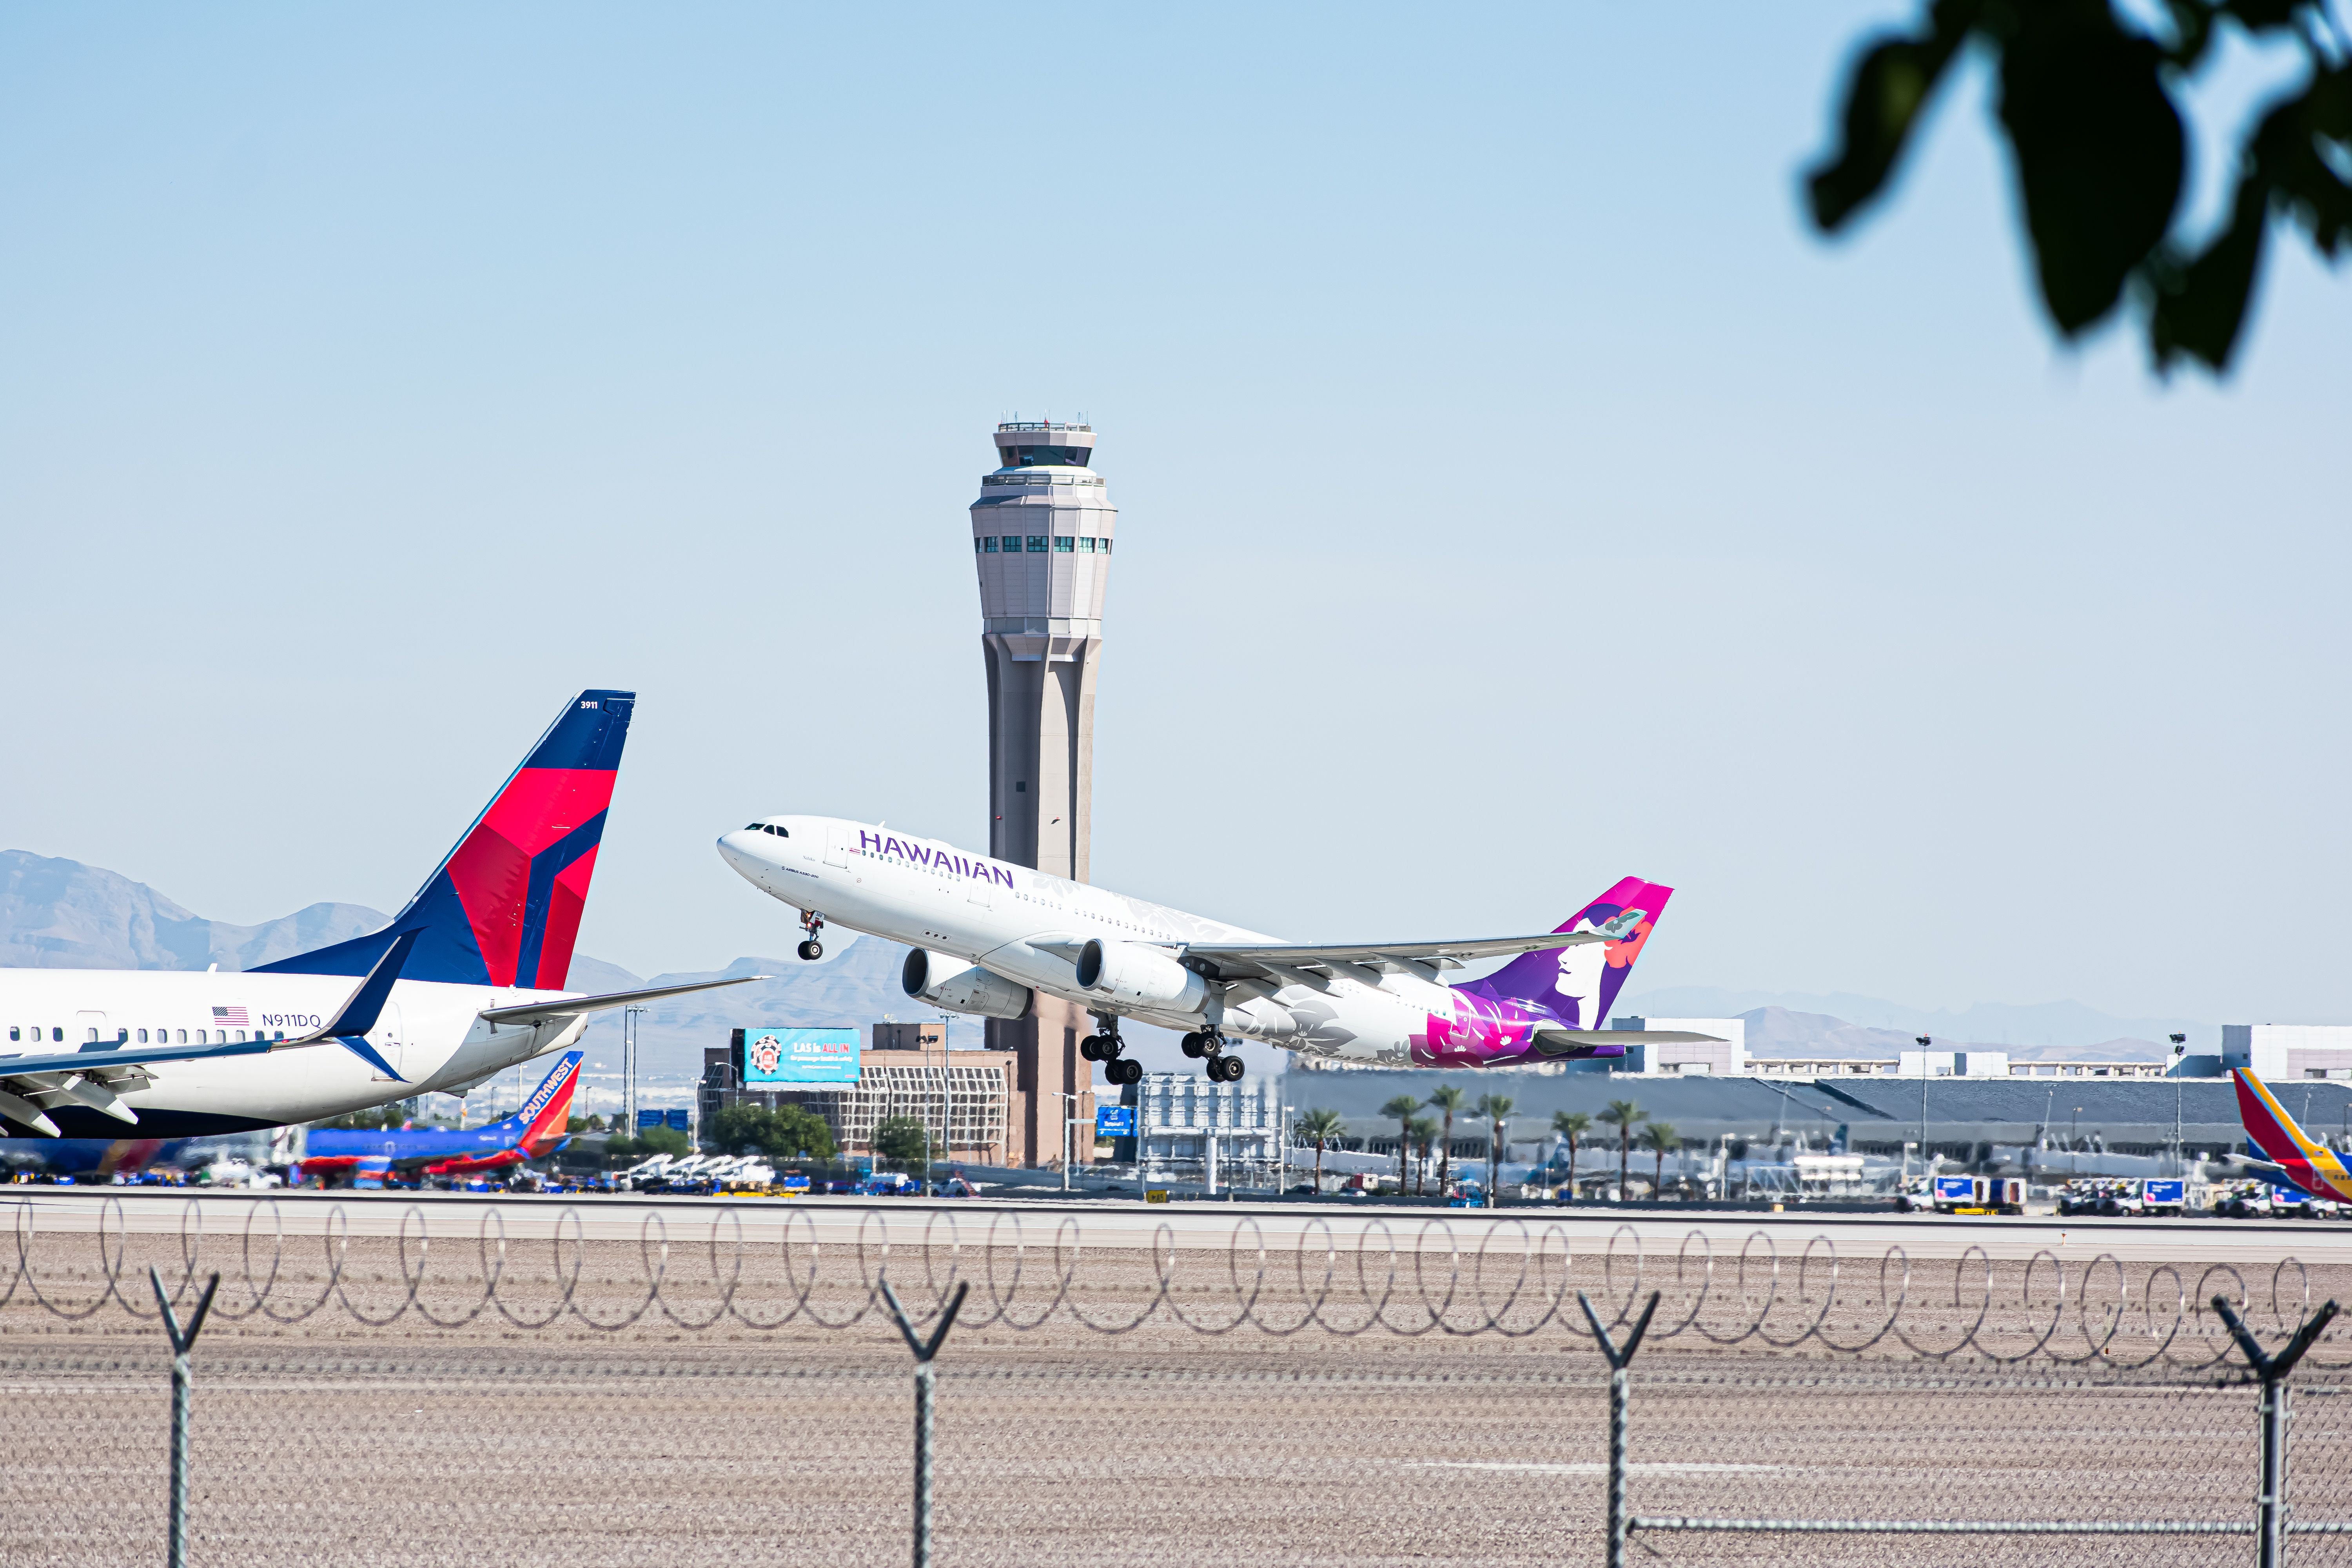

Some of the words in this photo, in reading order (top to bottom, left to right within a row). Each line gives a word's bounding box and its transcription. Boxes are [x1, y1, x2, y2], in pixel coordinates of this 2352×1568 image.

[581, 701, 598, 709] 3911
[860, 830, 1013, 889] HAWAIIAN
[262, 1014, 321, 1029] N911DQ
[793, 1042, 812, 1053] LAS
[822, 1043, 838, 1053] ALL
[839, 1043, 850, 1053] IN
[519, 1058, 573, 1125] SOUTHWEST
